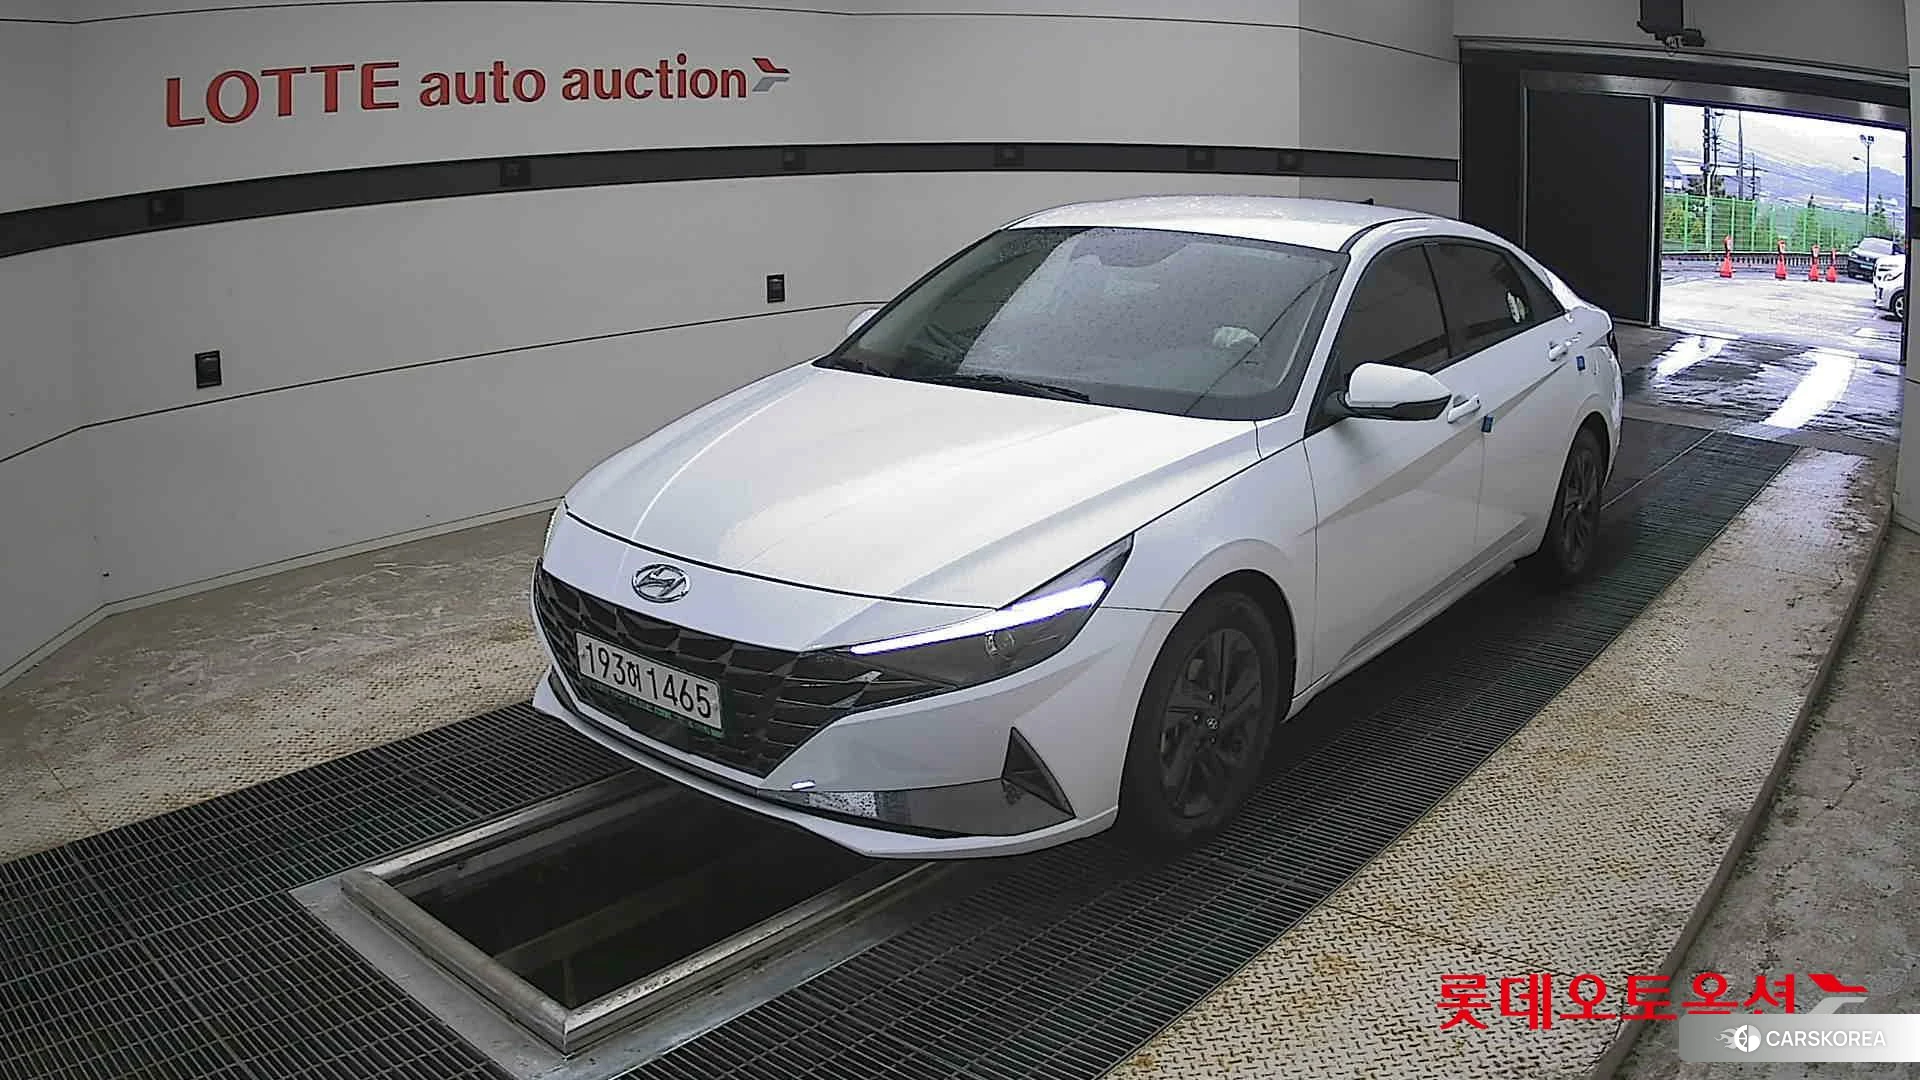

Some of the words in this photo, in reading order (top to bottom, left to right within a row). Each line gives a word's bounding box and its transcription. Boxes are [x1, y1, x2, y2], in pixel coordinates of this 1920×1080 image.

[166, 61, 399, 128] LOTTE
[419, 60, 546, 108] auto
[562, 53, 747, 101] auction
